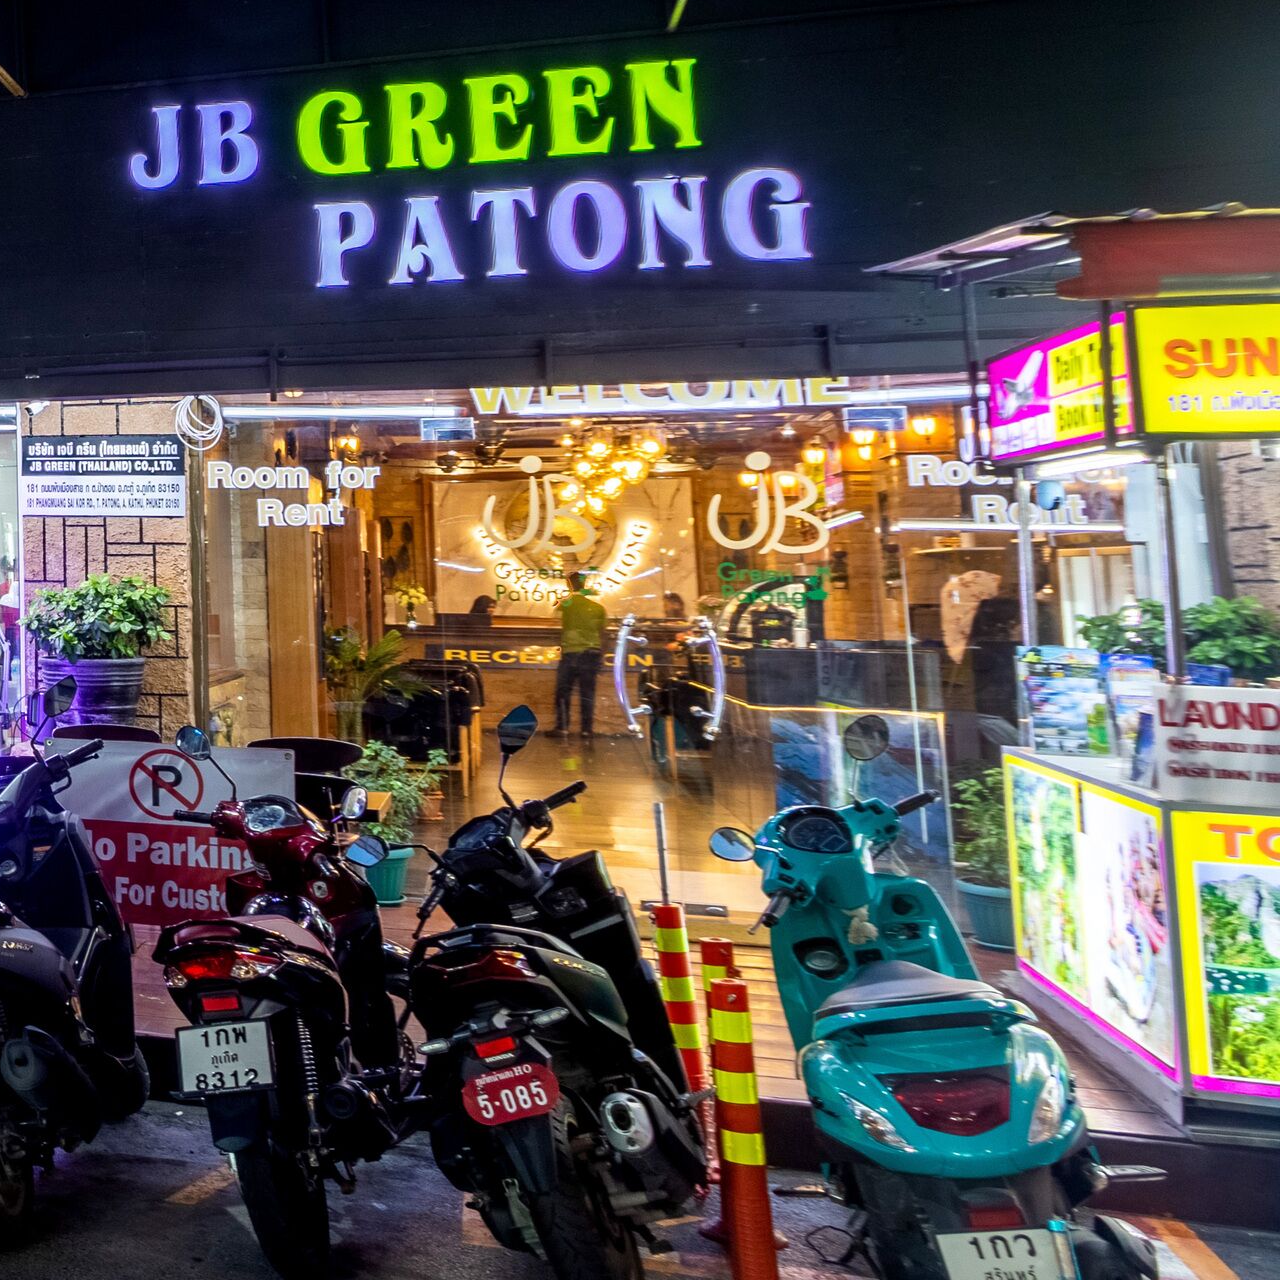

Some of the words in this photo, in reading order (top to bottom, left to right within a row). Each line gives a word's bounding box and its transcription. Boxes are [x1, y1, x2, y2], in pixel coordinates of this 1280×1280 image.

[129, 98, 261, 191] JB
[296, 57, 704, 177] GREEN
[312, 165, 815, 289] PATONG
[1056, 347, 1083, 385] Daily
[1168, 394, 1202, 412] 181
[28, 442, 54, 456] บริษัท
[57, 443, 74, 456] เจบี
[76, 442, 96, 456] กรีน
[99, 440, 150, 457] (ไทยแลนด์)
[152, 441, 178, 455] จำกัด
[29, 461, 42, 471] JB
[44, 461, 76, 471] GREEN
[78, 461, 132, 473] (THAILAND)
[207, 461, 309, 490] Room
[325, 461, 381, 490] for
[27, 483, 39, 493] 181
[157, 483, 180, 493] 83150
[257, 498, 345, 528] Rent
[717, 562, 793, 583] Green
[89, 830, 116, 861] o
[115, 876, 155, 907] For
[211, 1050, 239, 1068] ภูเก็ต
[195, 1068, 260, 1091] 8312
